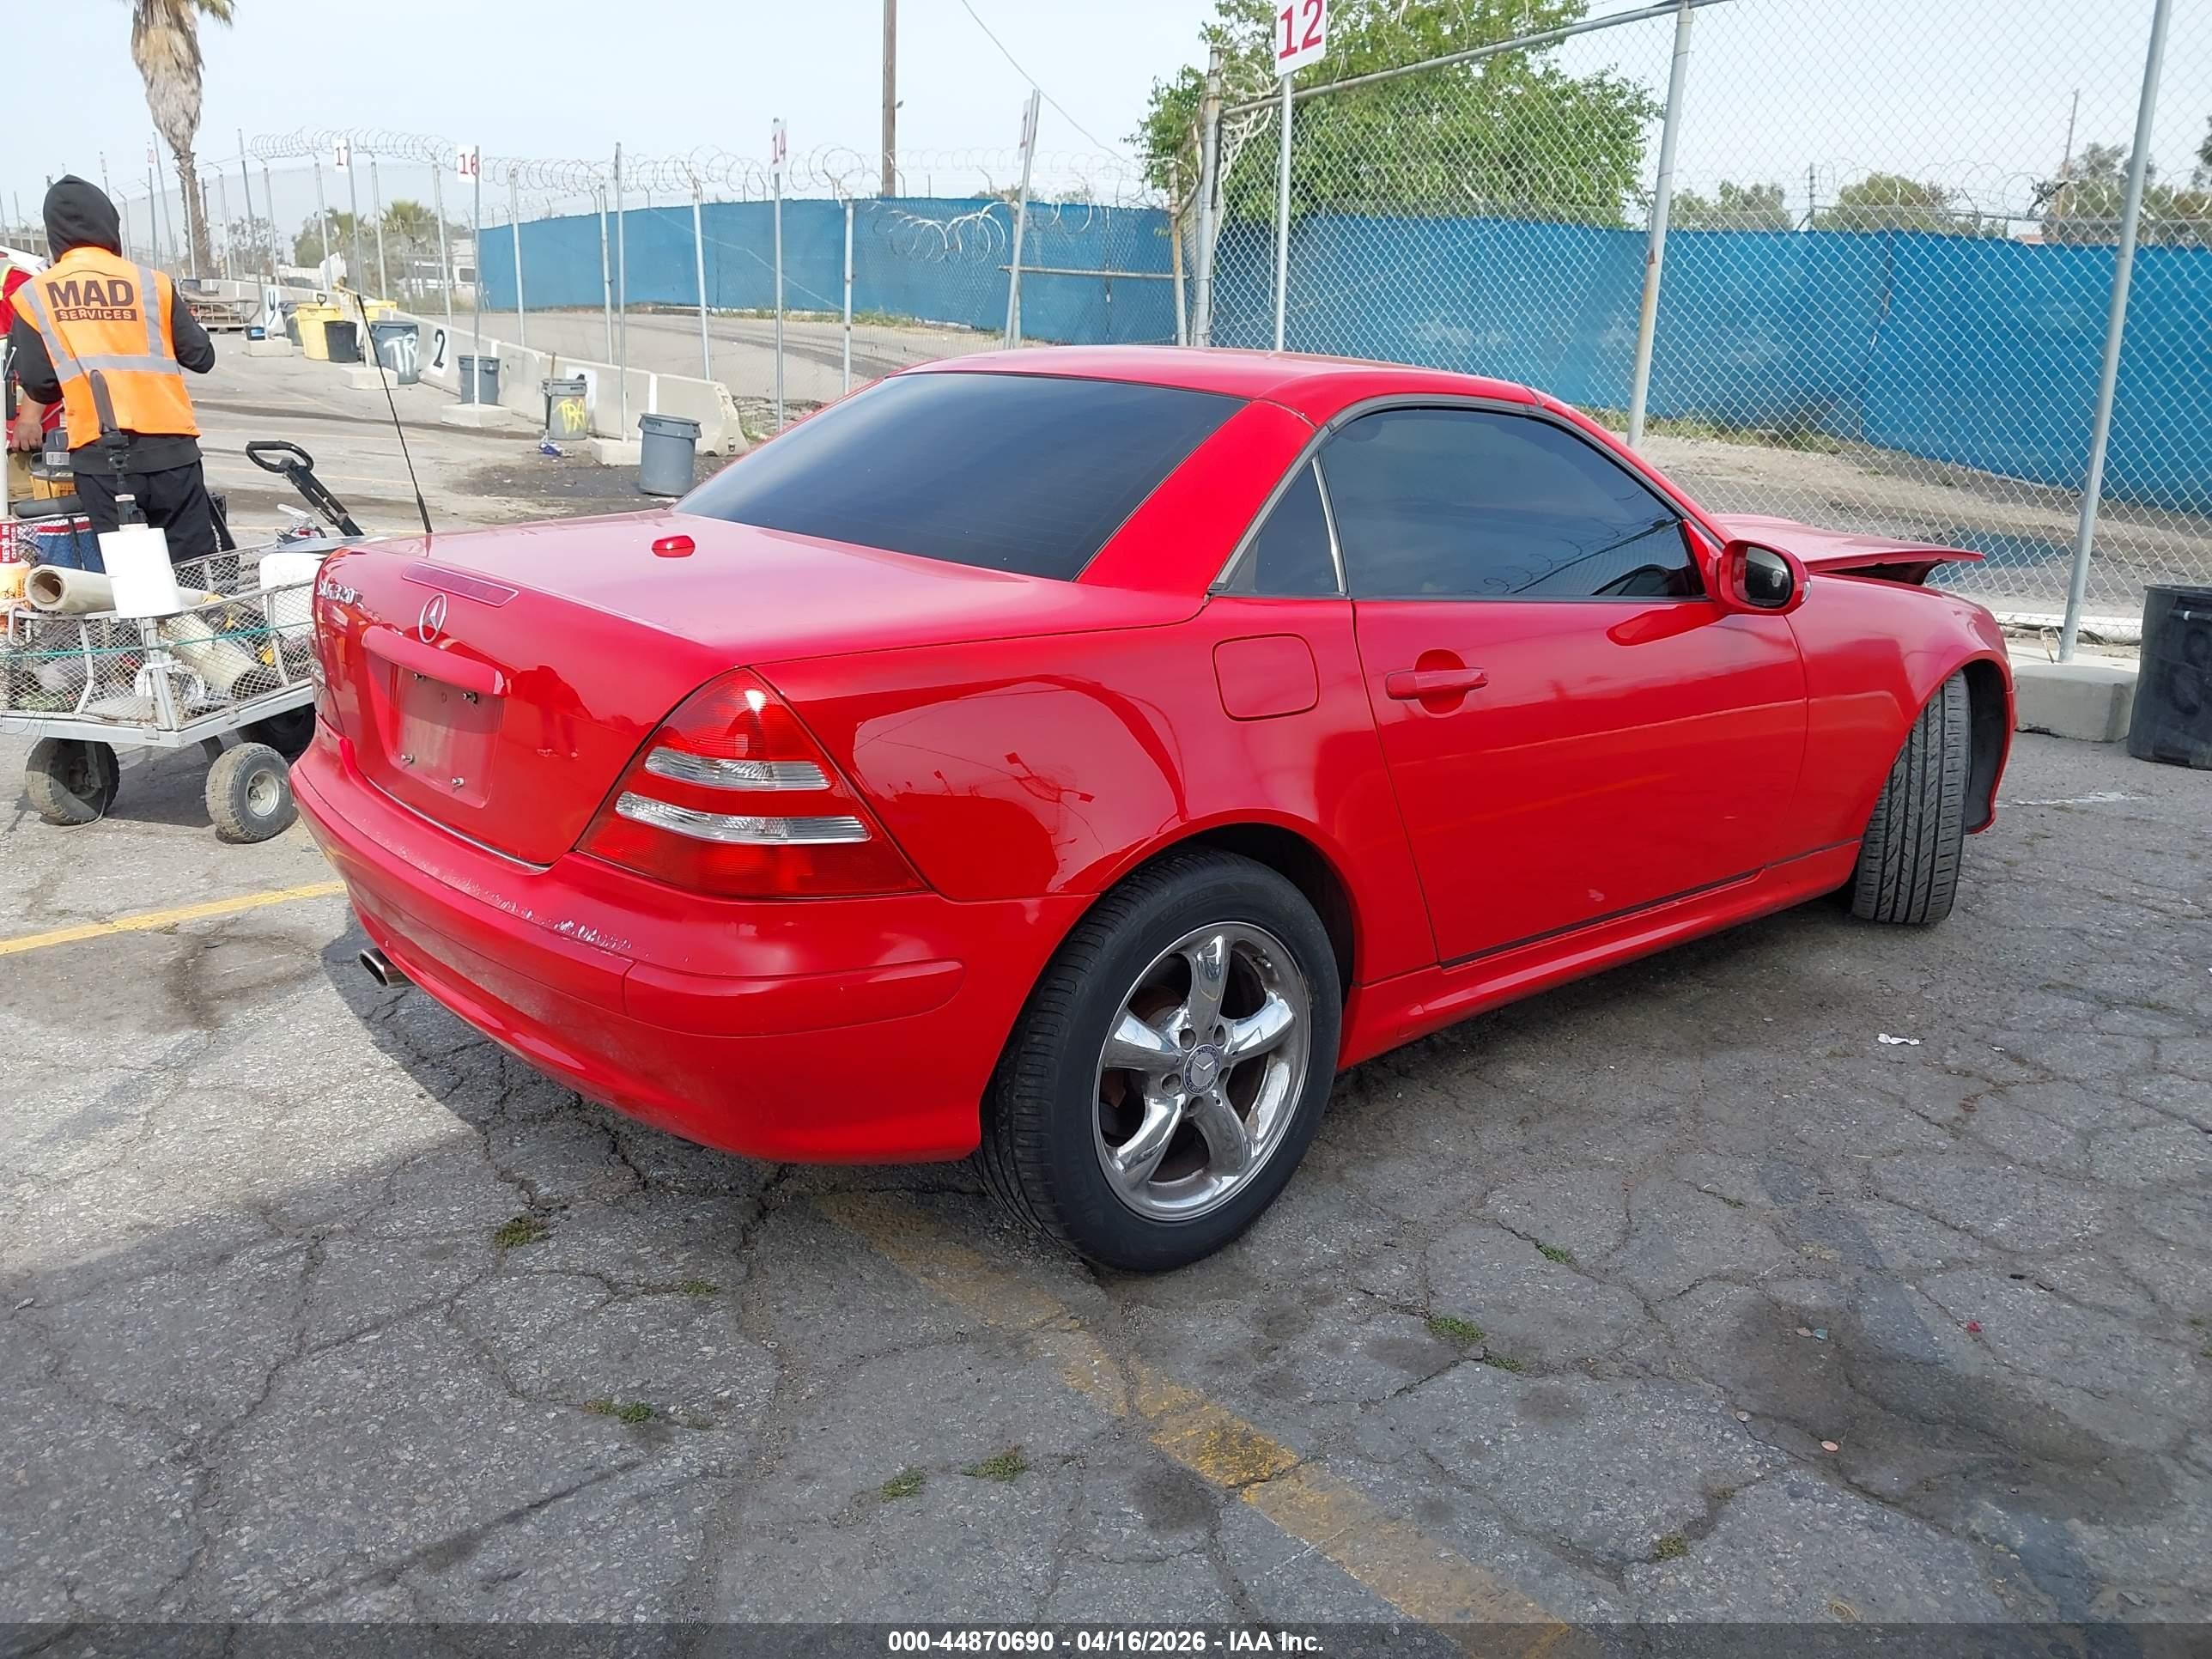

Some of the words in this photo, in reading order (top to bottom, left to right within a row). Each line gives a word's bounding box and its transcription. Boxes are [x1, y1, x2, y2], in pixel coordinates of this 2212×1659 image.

[1279, 0, 1323, 59] 12
[772, 129, 786, 164] 14
[459, 153, 480, 178] 16
[46, 279, 135, 308] MAD
[58, 309, 133, 321] SERVICES
[433, 328, 446, 369] 2
[2, 525, 10, 536] IN
[2, 538, 10, 562] KEYS
